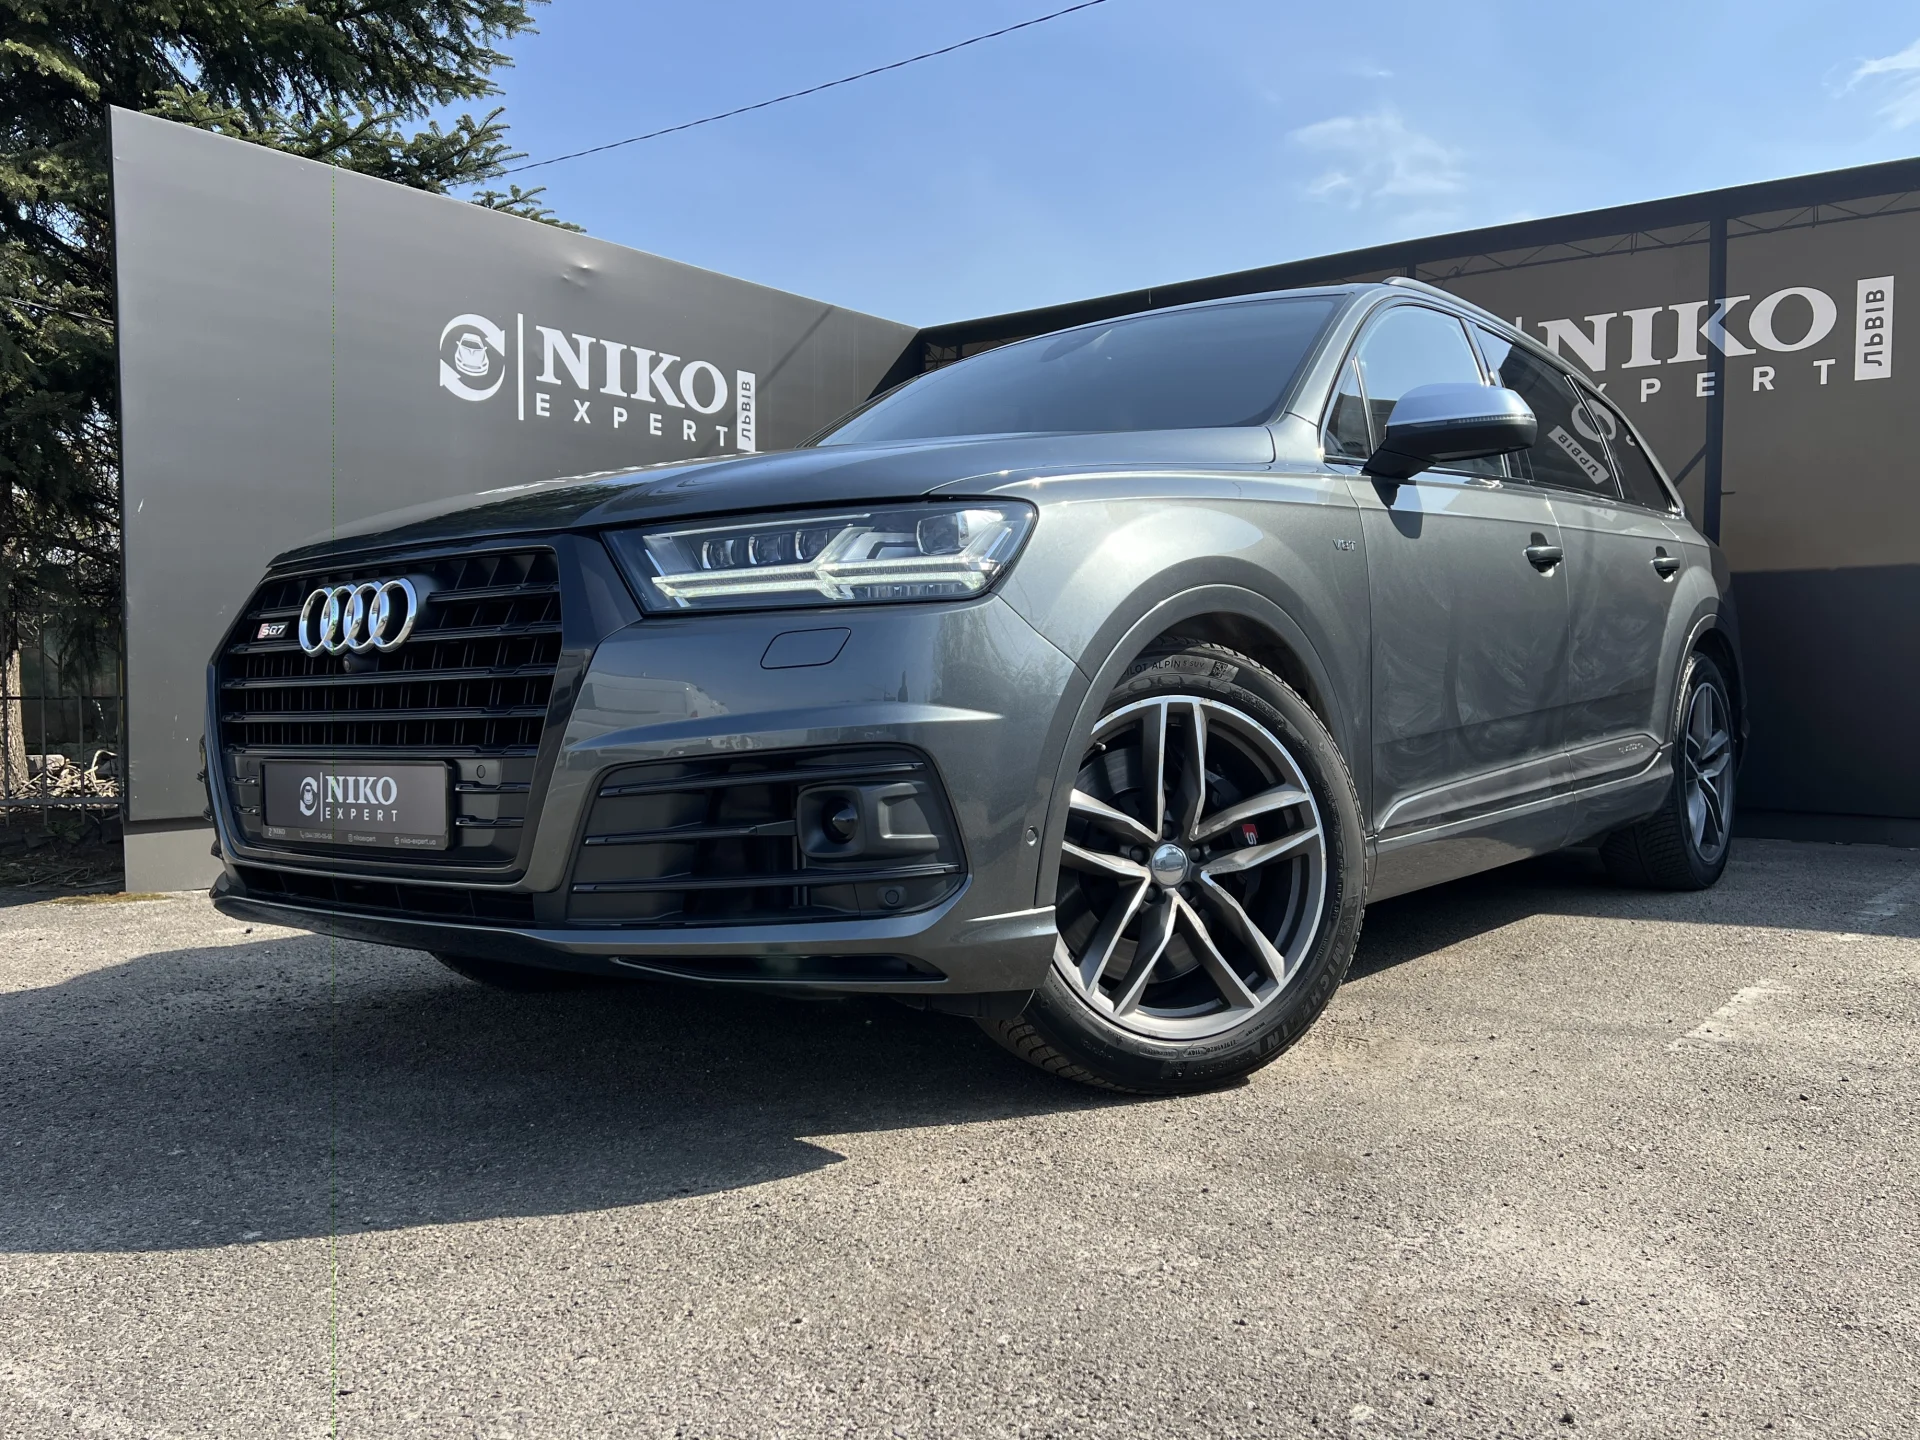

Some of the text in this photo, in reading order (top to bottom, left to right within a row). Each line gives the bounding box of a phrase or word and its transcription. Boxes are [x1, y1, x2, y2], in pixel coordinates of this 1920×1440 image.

[1538, 286, 1837, 372] NIKO
[1863, 289, 1885, 367] ЛЬВІВ
[536, 325, 728, 414] NIKO
[1597, 358, 1836, 403] PERT
[536, 392, 728, 447] EXPERT
[740, 381, 752, 441] ЛЬВІВ
[261, 624, 286, 636] SQ7
[1152, 660, 1181, 670] ALPIN
[325, 775, 398, 805] NIKO
[325, 807, 398, 822] EXPERT
[1267, 941, 1347, 1049] MICHELIN
